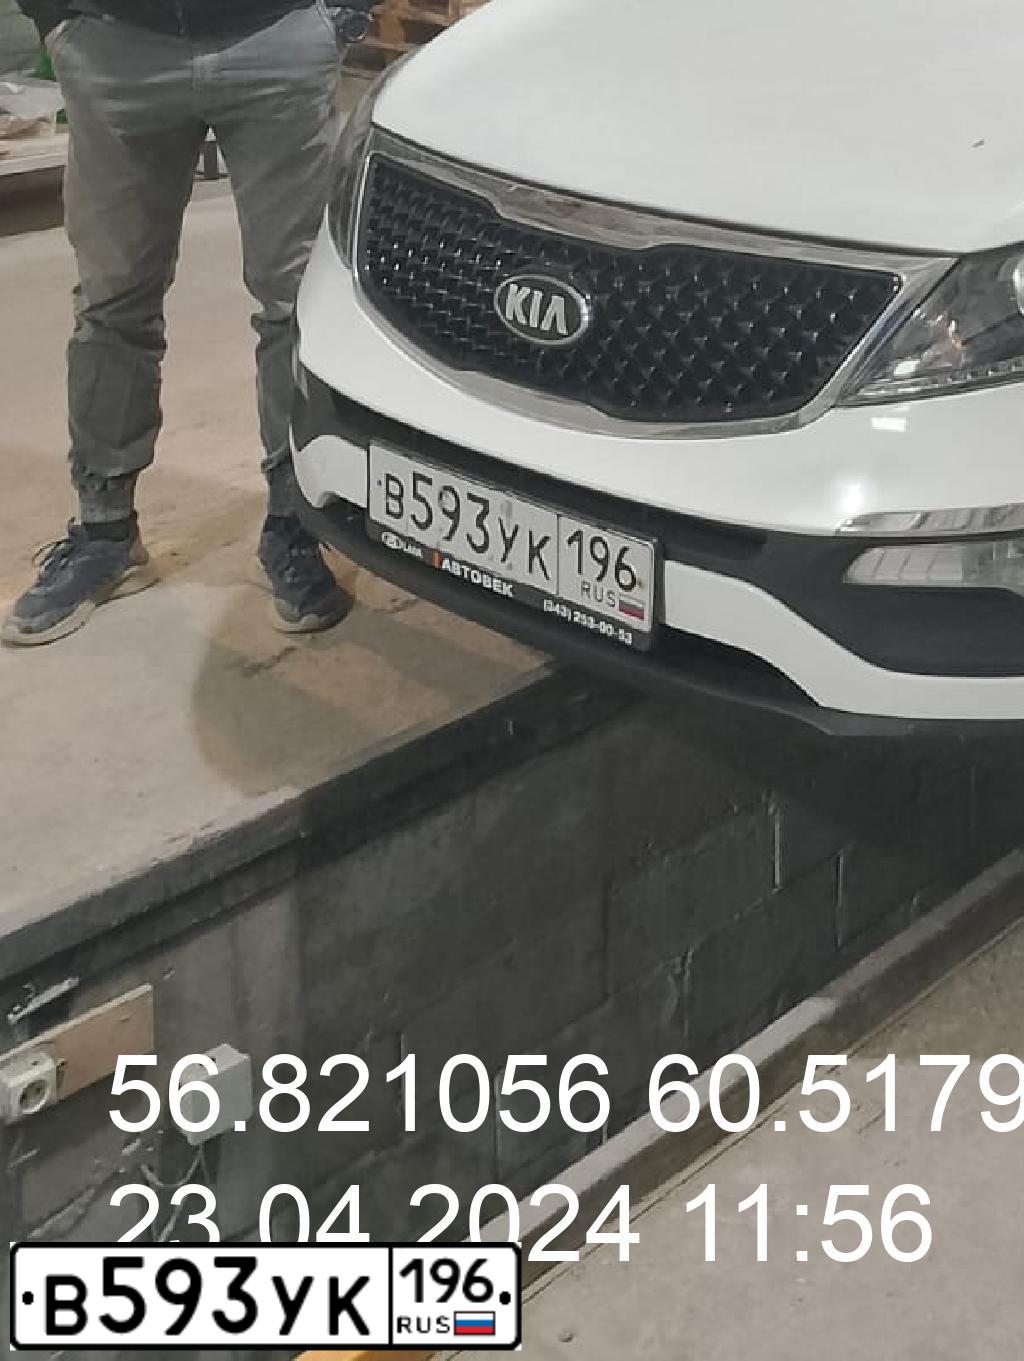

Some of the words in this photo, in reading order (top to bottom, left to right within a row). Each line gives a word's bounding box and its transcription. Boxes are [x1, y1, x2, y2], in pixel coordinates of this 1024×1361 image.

[505, 283, 569, 335] KIA
[384, 472, 551, 581] В593УК
[567, 529, 638, 592] 196
[580, 581, 616, 608] RUS
